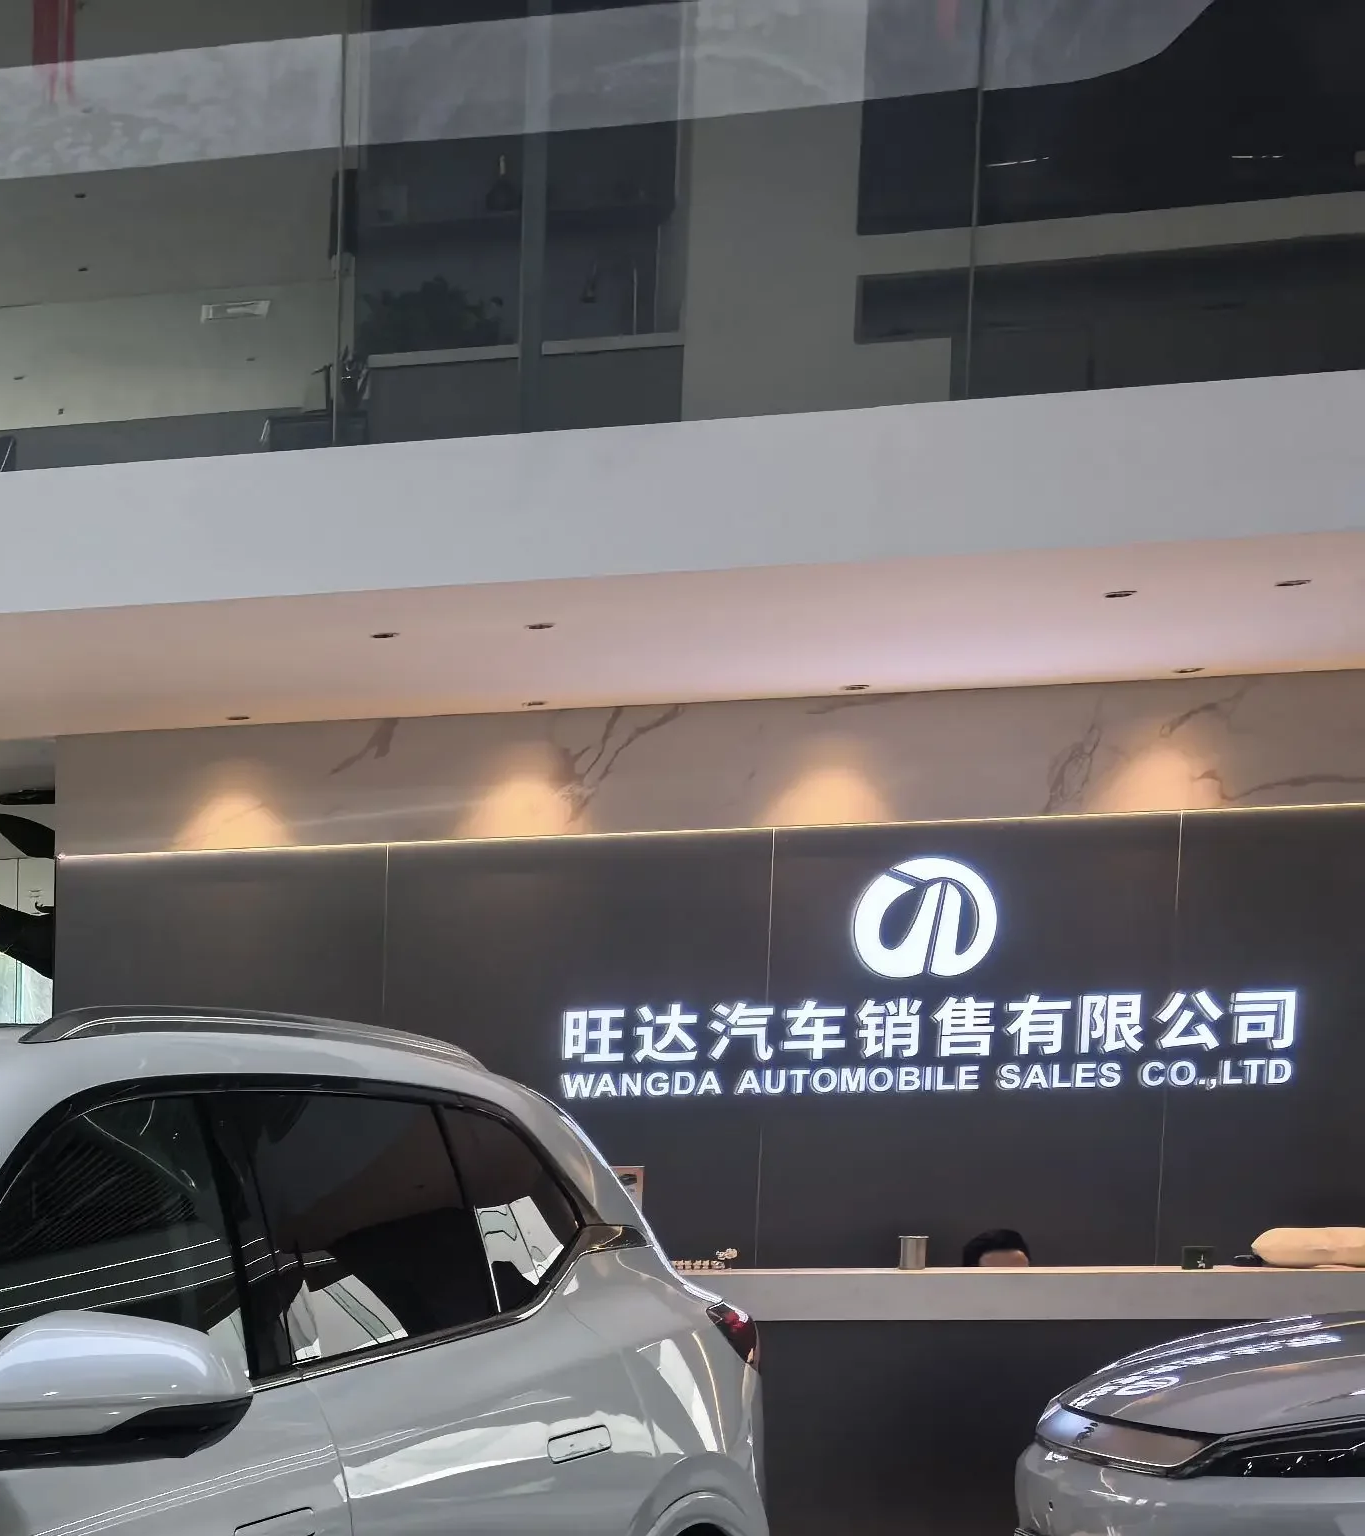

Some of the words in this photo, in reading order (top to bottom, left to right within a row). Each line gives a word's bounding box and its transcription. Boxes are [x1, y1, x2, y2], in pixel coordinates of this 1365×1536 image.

[563, 990, 1295, 1064] 旺达汽车销售有限公司
[562, 1071, 722, 1098] WANGDA
[736, 1065, 980, 1096] AUTOMOBILE
[997, 1060, 1121, 1091] SALES
